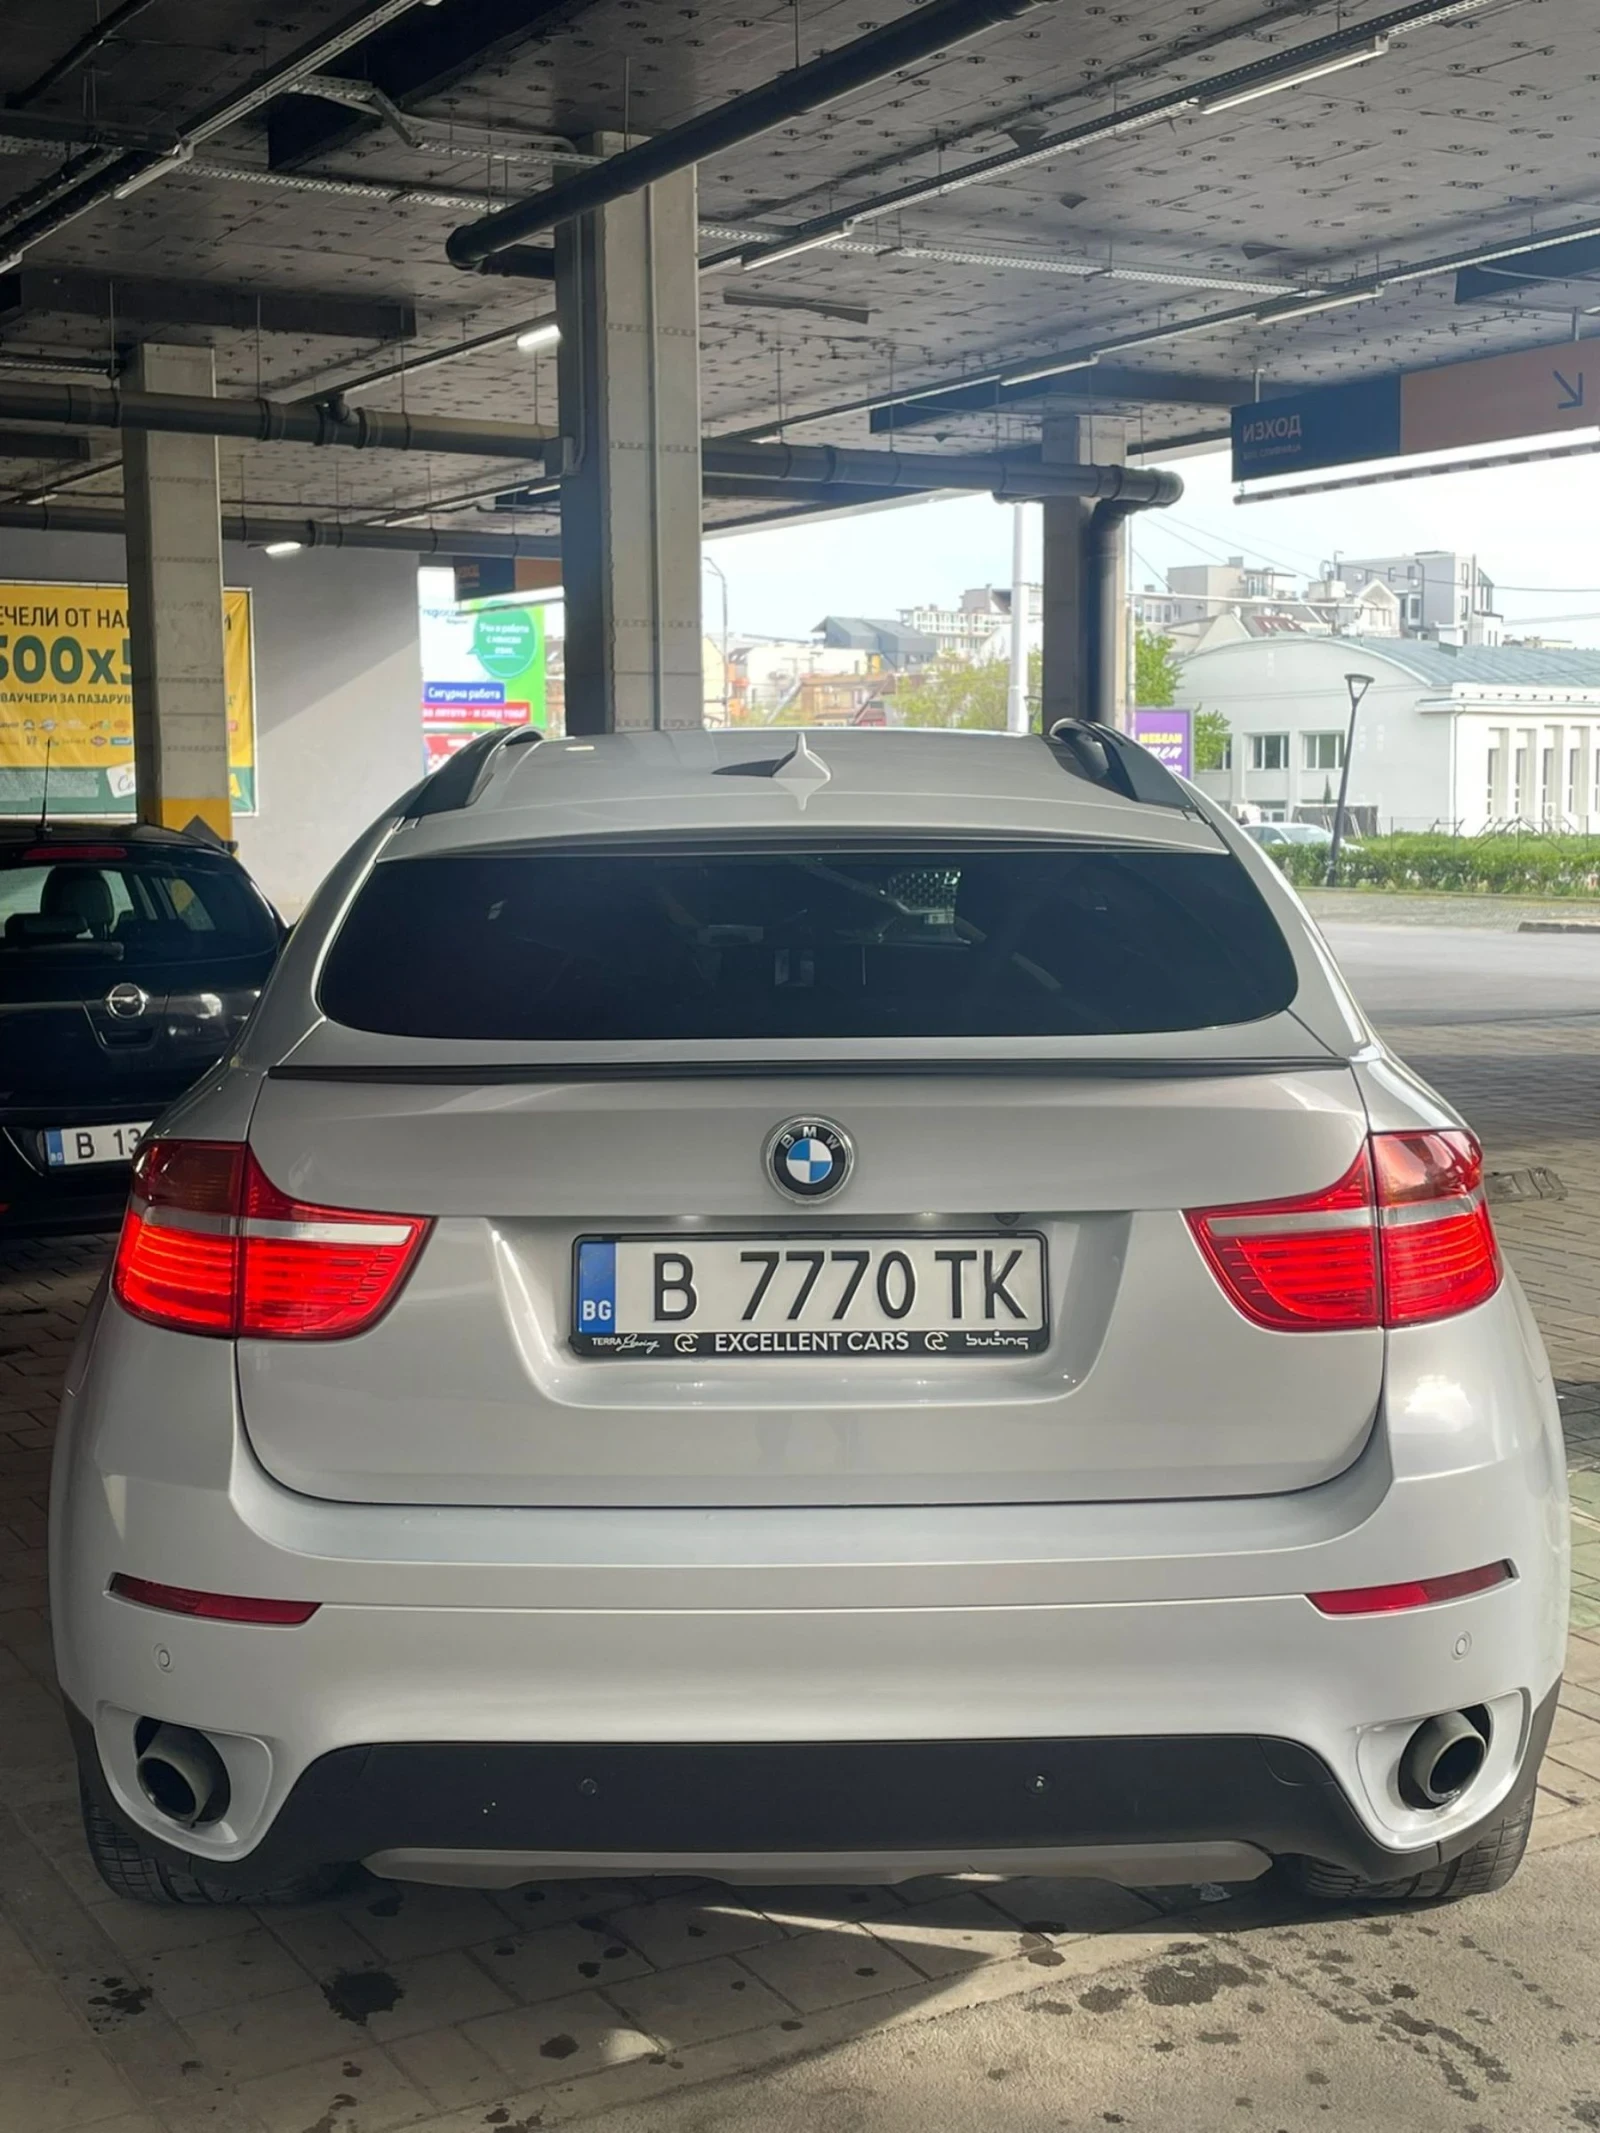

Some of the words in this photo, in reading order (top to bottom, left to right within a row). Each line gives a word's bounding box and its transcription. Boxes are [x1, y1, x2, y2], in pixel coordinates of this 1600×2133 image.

[1242, 414, 1303, 443] ИЗХОД
[64, 607, 91, 628] ОТ
[97, 608, 130, 629] НА
[60, 693, 75, 703] ЗА
[428, 687, 468, 702] Сигурна
[468, 688, 501, 702] работа
[780, 1126, 841, 1150] BMW
[653, 1252, 698, 1321] B
[740, 1250, 916, 1320] 7770
[934, 1249, 1028, 1320] TK
[582, 1300, 612, 1321] BG
[591, 1337, 622, 1346] TERRA
[715, 1333, 842, 1352] EXCELLENT
[847, 1332, 909, 1351] CARS
